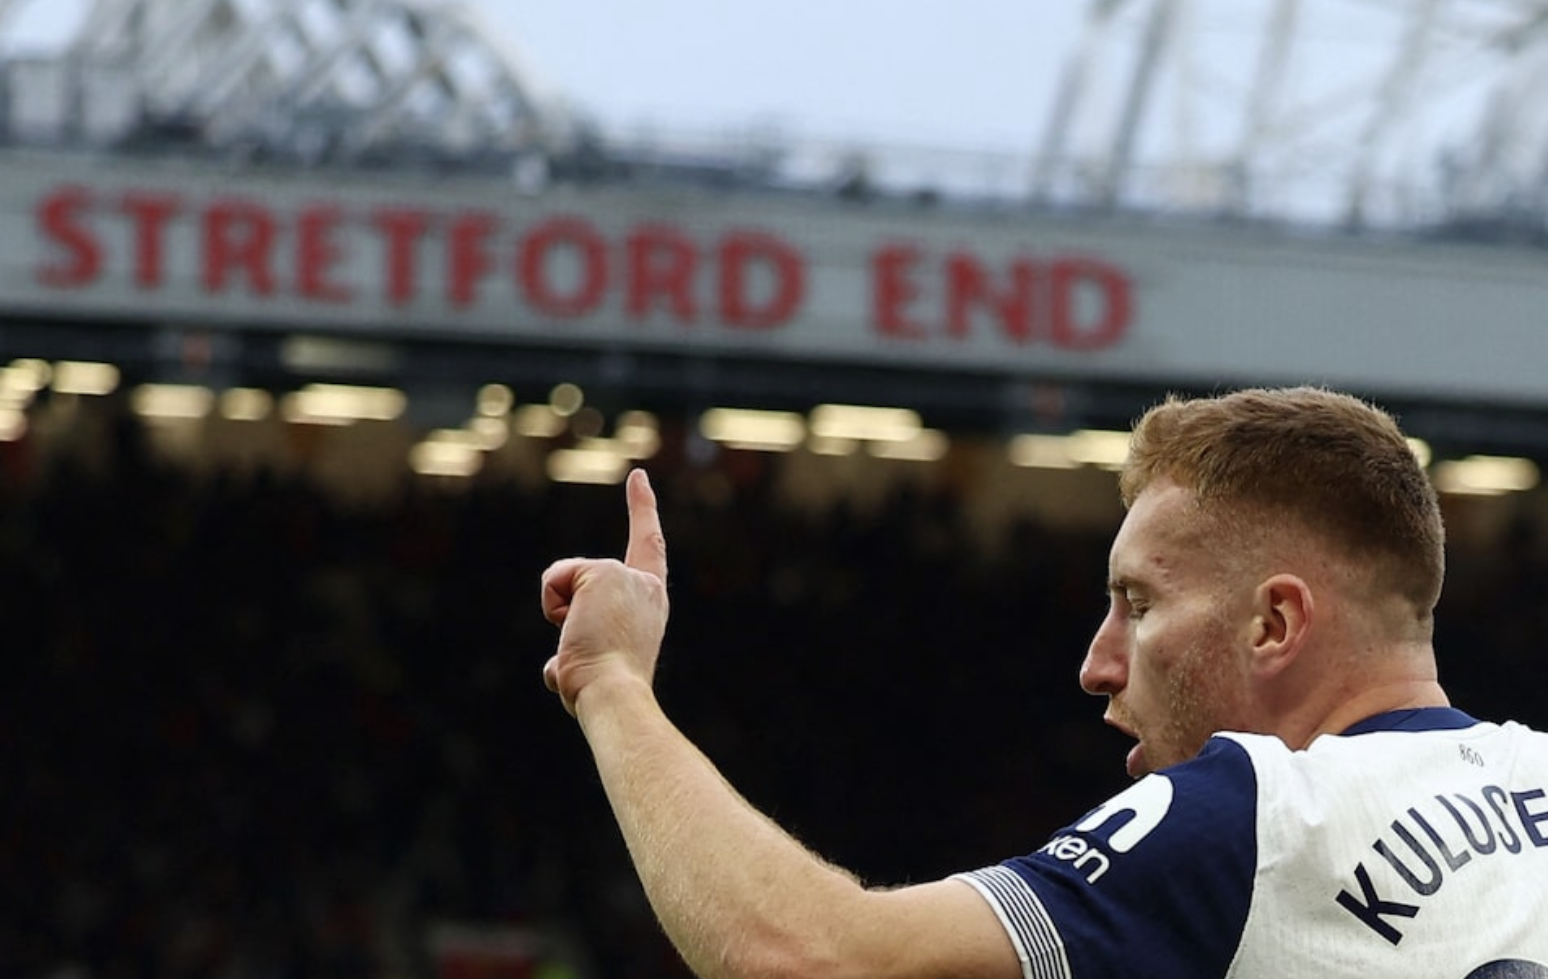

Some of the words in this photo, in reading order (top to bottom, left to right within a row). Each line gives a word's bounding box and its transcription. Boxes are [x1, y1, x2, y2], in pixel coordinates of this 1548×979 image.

[35, 187, 806, 329] STRETFORD
[872, 240, 1136, 351] END
[1458, 743, 1485, 767] 860
